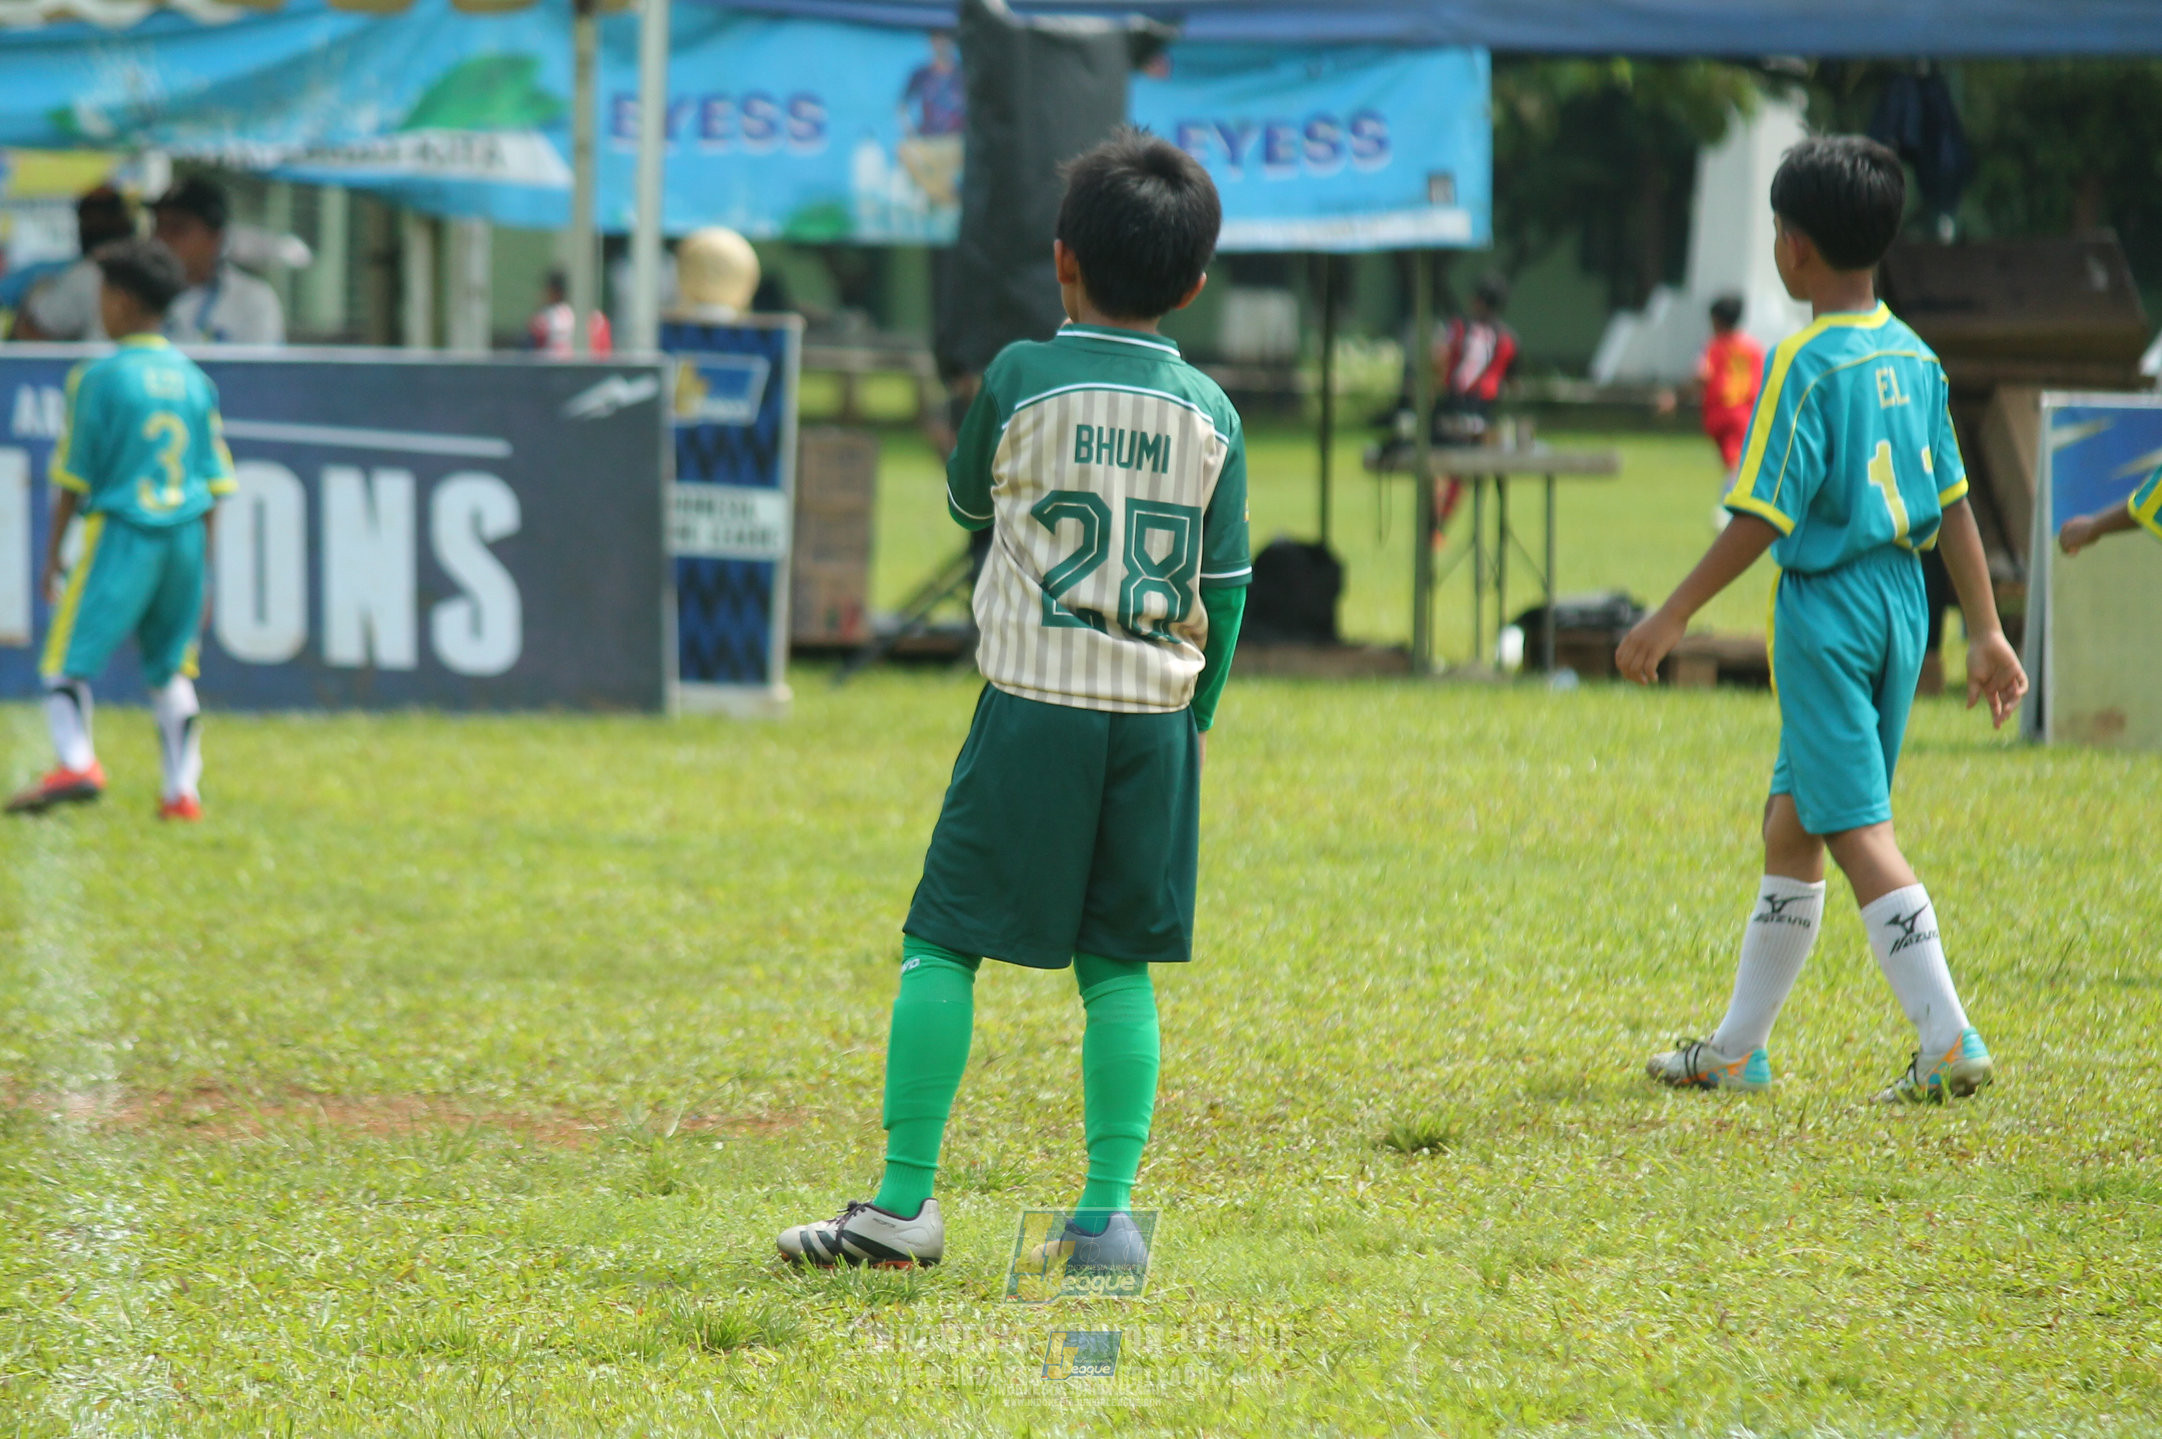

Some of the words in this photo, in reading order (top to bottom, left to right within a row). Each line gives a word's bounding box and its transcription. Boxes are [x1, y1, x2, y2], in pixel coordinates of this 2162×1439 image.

[1173, 108, 1392, 177] EYESS
[1875, 366, 1910, 409] EL
[138, 411, 191, 516] 3
[1074, 424, 1171, 474] BHUMI
[1030, 490, 1202, 644] 28
